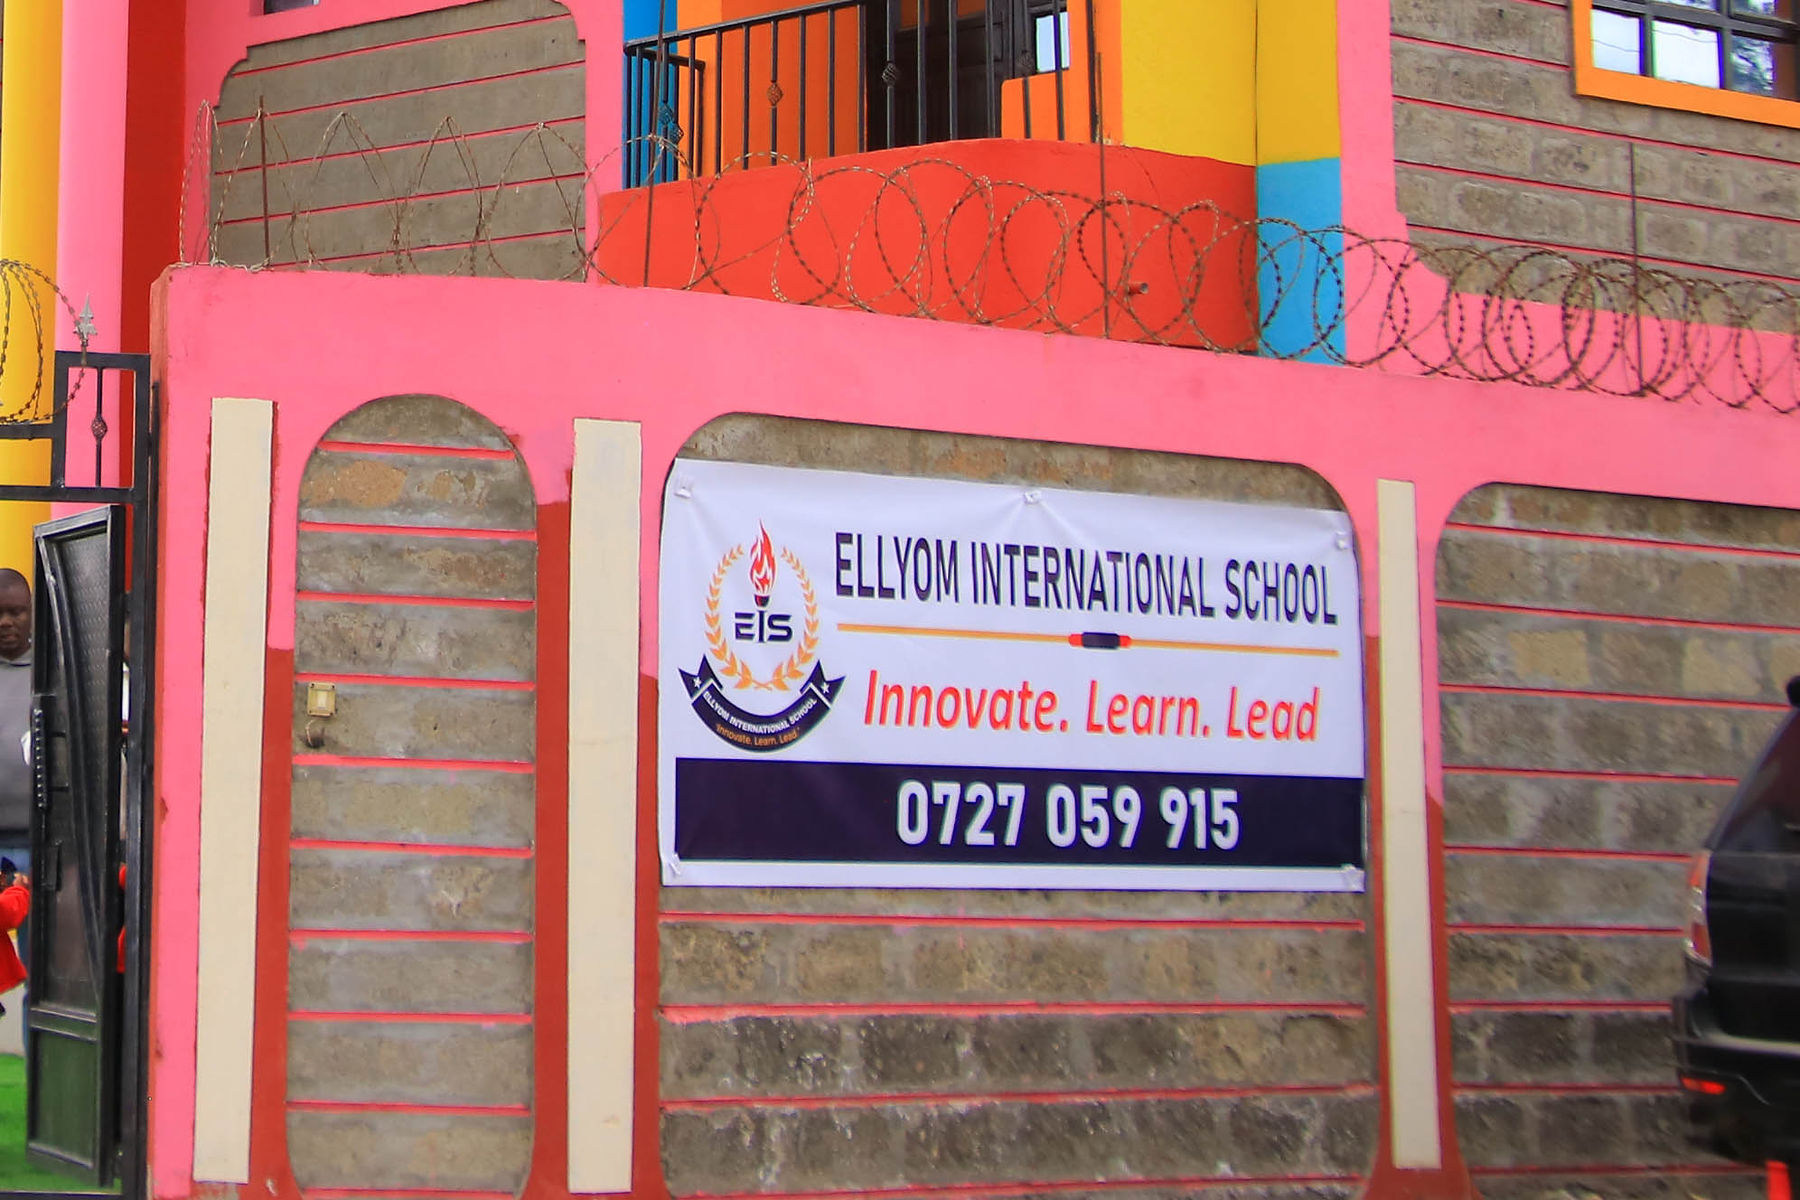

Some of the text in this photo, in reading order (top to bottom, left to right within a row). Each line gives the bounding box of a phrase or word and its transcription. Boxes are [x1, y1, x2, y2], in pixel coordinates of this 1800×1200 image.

[835, 532, 1338, 625] ELLYOM INTERNATIONAL SCHOOL
[734, 610, 793, 643] EIS
[702, 691, 817, 735] ELLYOM INTERNATIONAL SCHOOL
[864, 669, 1320, 742] Innovate. Learn. Lead
[896, 779, 1239, 851] 0727 059 915
